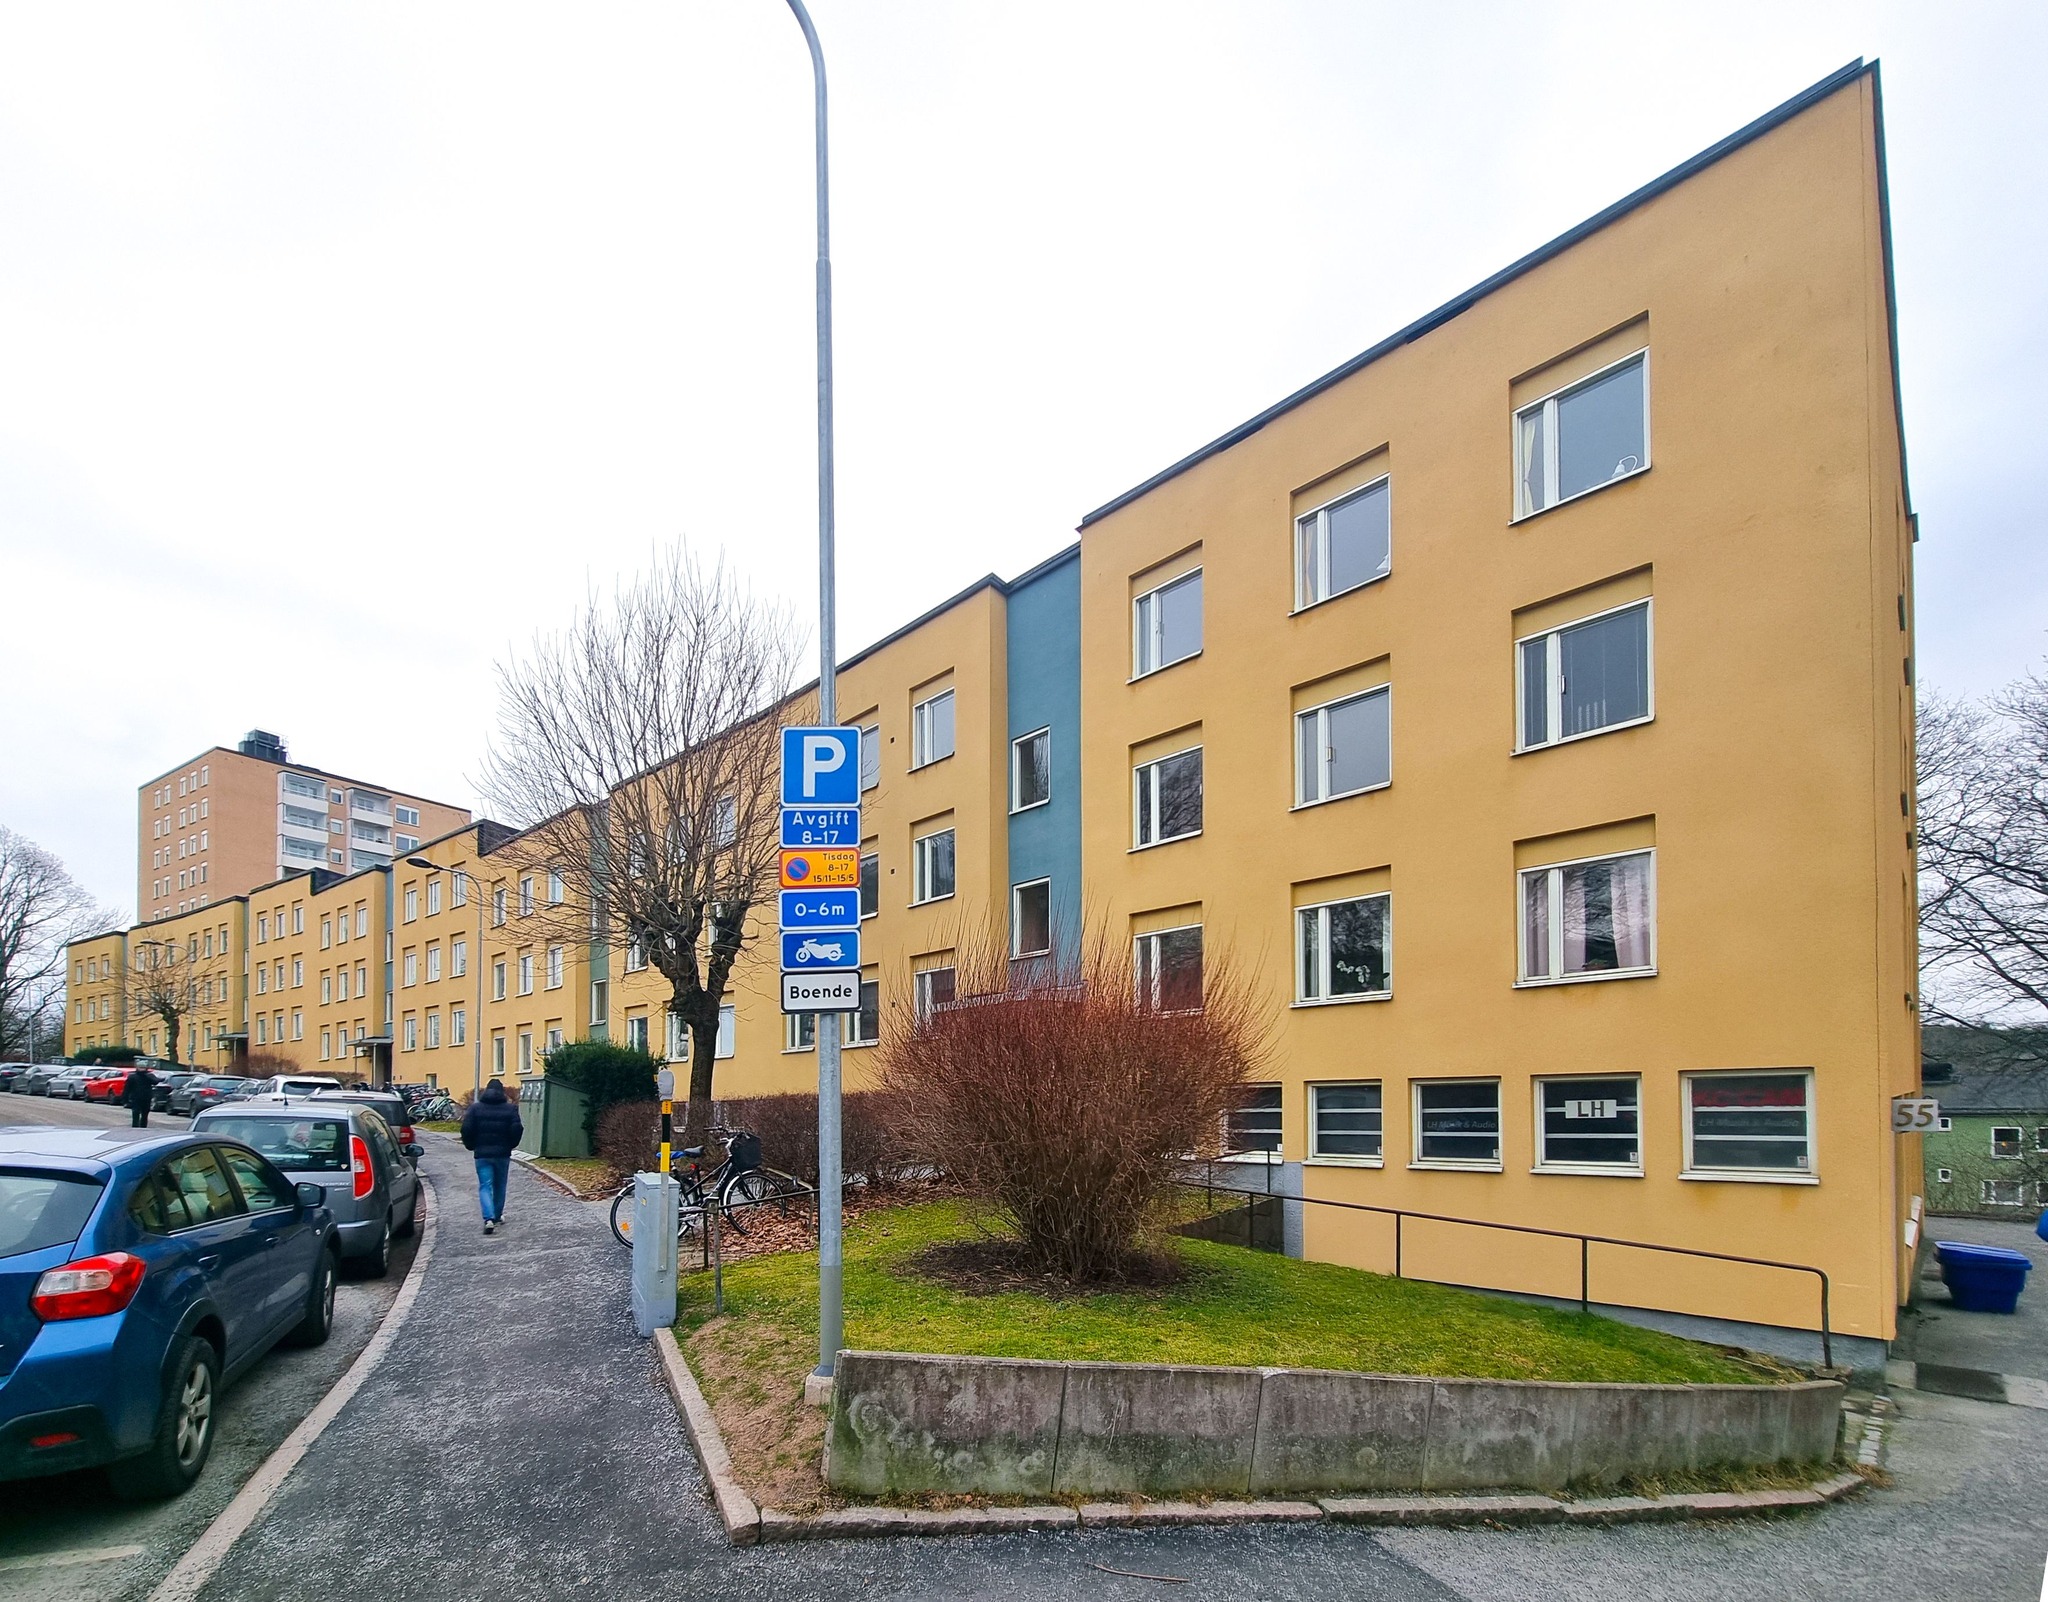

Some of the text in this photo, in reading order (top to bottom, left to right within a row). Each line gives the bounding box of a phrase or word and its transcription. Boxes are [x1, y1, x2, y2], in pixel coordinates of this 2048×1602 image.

[803, 735, 847, 798] P
[792, 811, 849, 829] Avgift
[801, 830, 839, 844] 8-17
[822, 853, 855, 862] Tisdag
[827, 863, 849, 871] 8-17
[813, 873, 854, 883] 15/11-15/5
[789, 985, 853, 999] Boende
[1577, 1101, 1605, 1117] LH
[1895, 1104, 1934, 1127] 55
[1426, 1120, 1438, 1129] LH
[1471, 1120, 1497, 1129] Audio
